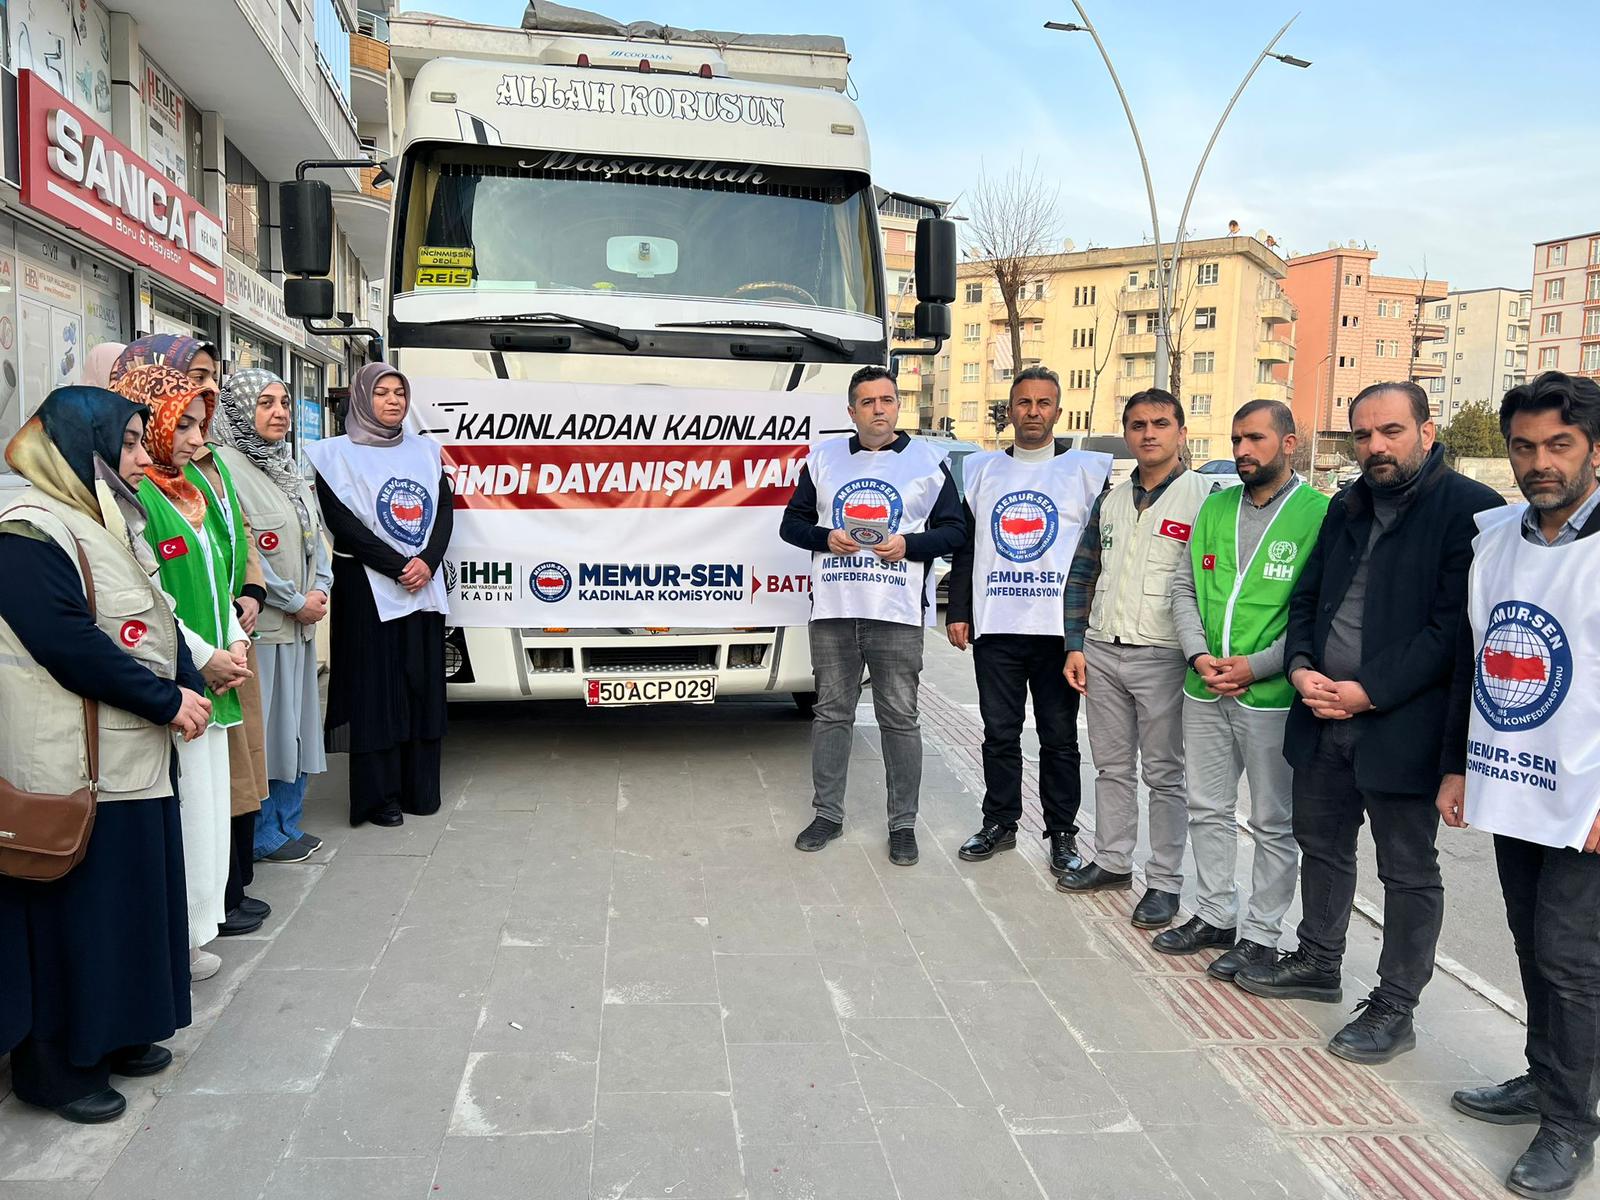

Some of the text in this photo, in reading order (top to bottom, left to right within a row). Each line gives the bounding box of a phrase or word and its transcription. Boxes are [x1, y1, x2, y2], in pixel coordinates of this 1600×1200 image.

[623, 51, 673, 61] COOLMAN
[147, 66, 183, 132] HEDEF
[497, 74, 786, 129] ALLAH KORUSUN
[47, 108, 189, 250] SANICA
[115, 216, 137, 240] Boru
[454, 413, 812, 441] KADINLARDAN KADINLARA
[536, 459, 733, 497] DAYANIŞMA
[838, 480, 898, 502] MEMUR-SEN
[995, 493, 1055, 514] MEMUR-SEN
[579, 563, 744, 587] MEMUR-SEN
[822, 556, 908, 573] MEMUR-SEN
[821, 571, 907, 587] KONFEDERASYONU
[461, 591, 513, 601] KADIN
[579, 590, 654, 601] KADINLAR
[986, 587, 1062, 597] NFEDERASYON
[1489, 606, 1564, 651] MUR-SEN
[1503, 665, 1564, 726] KONFEDERASYONU
